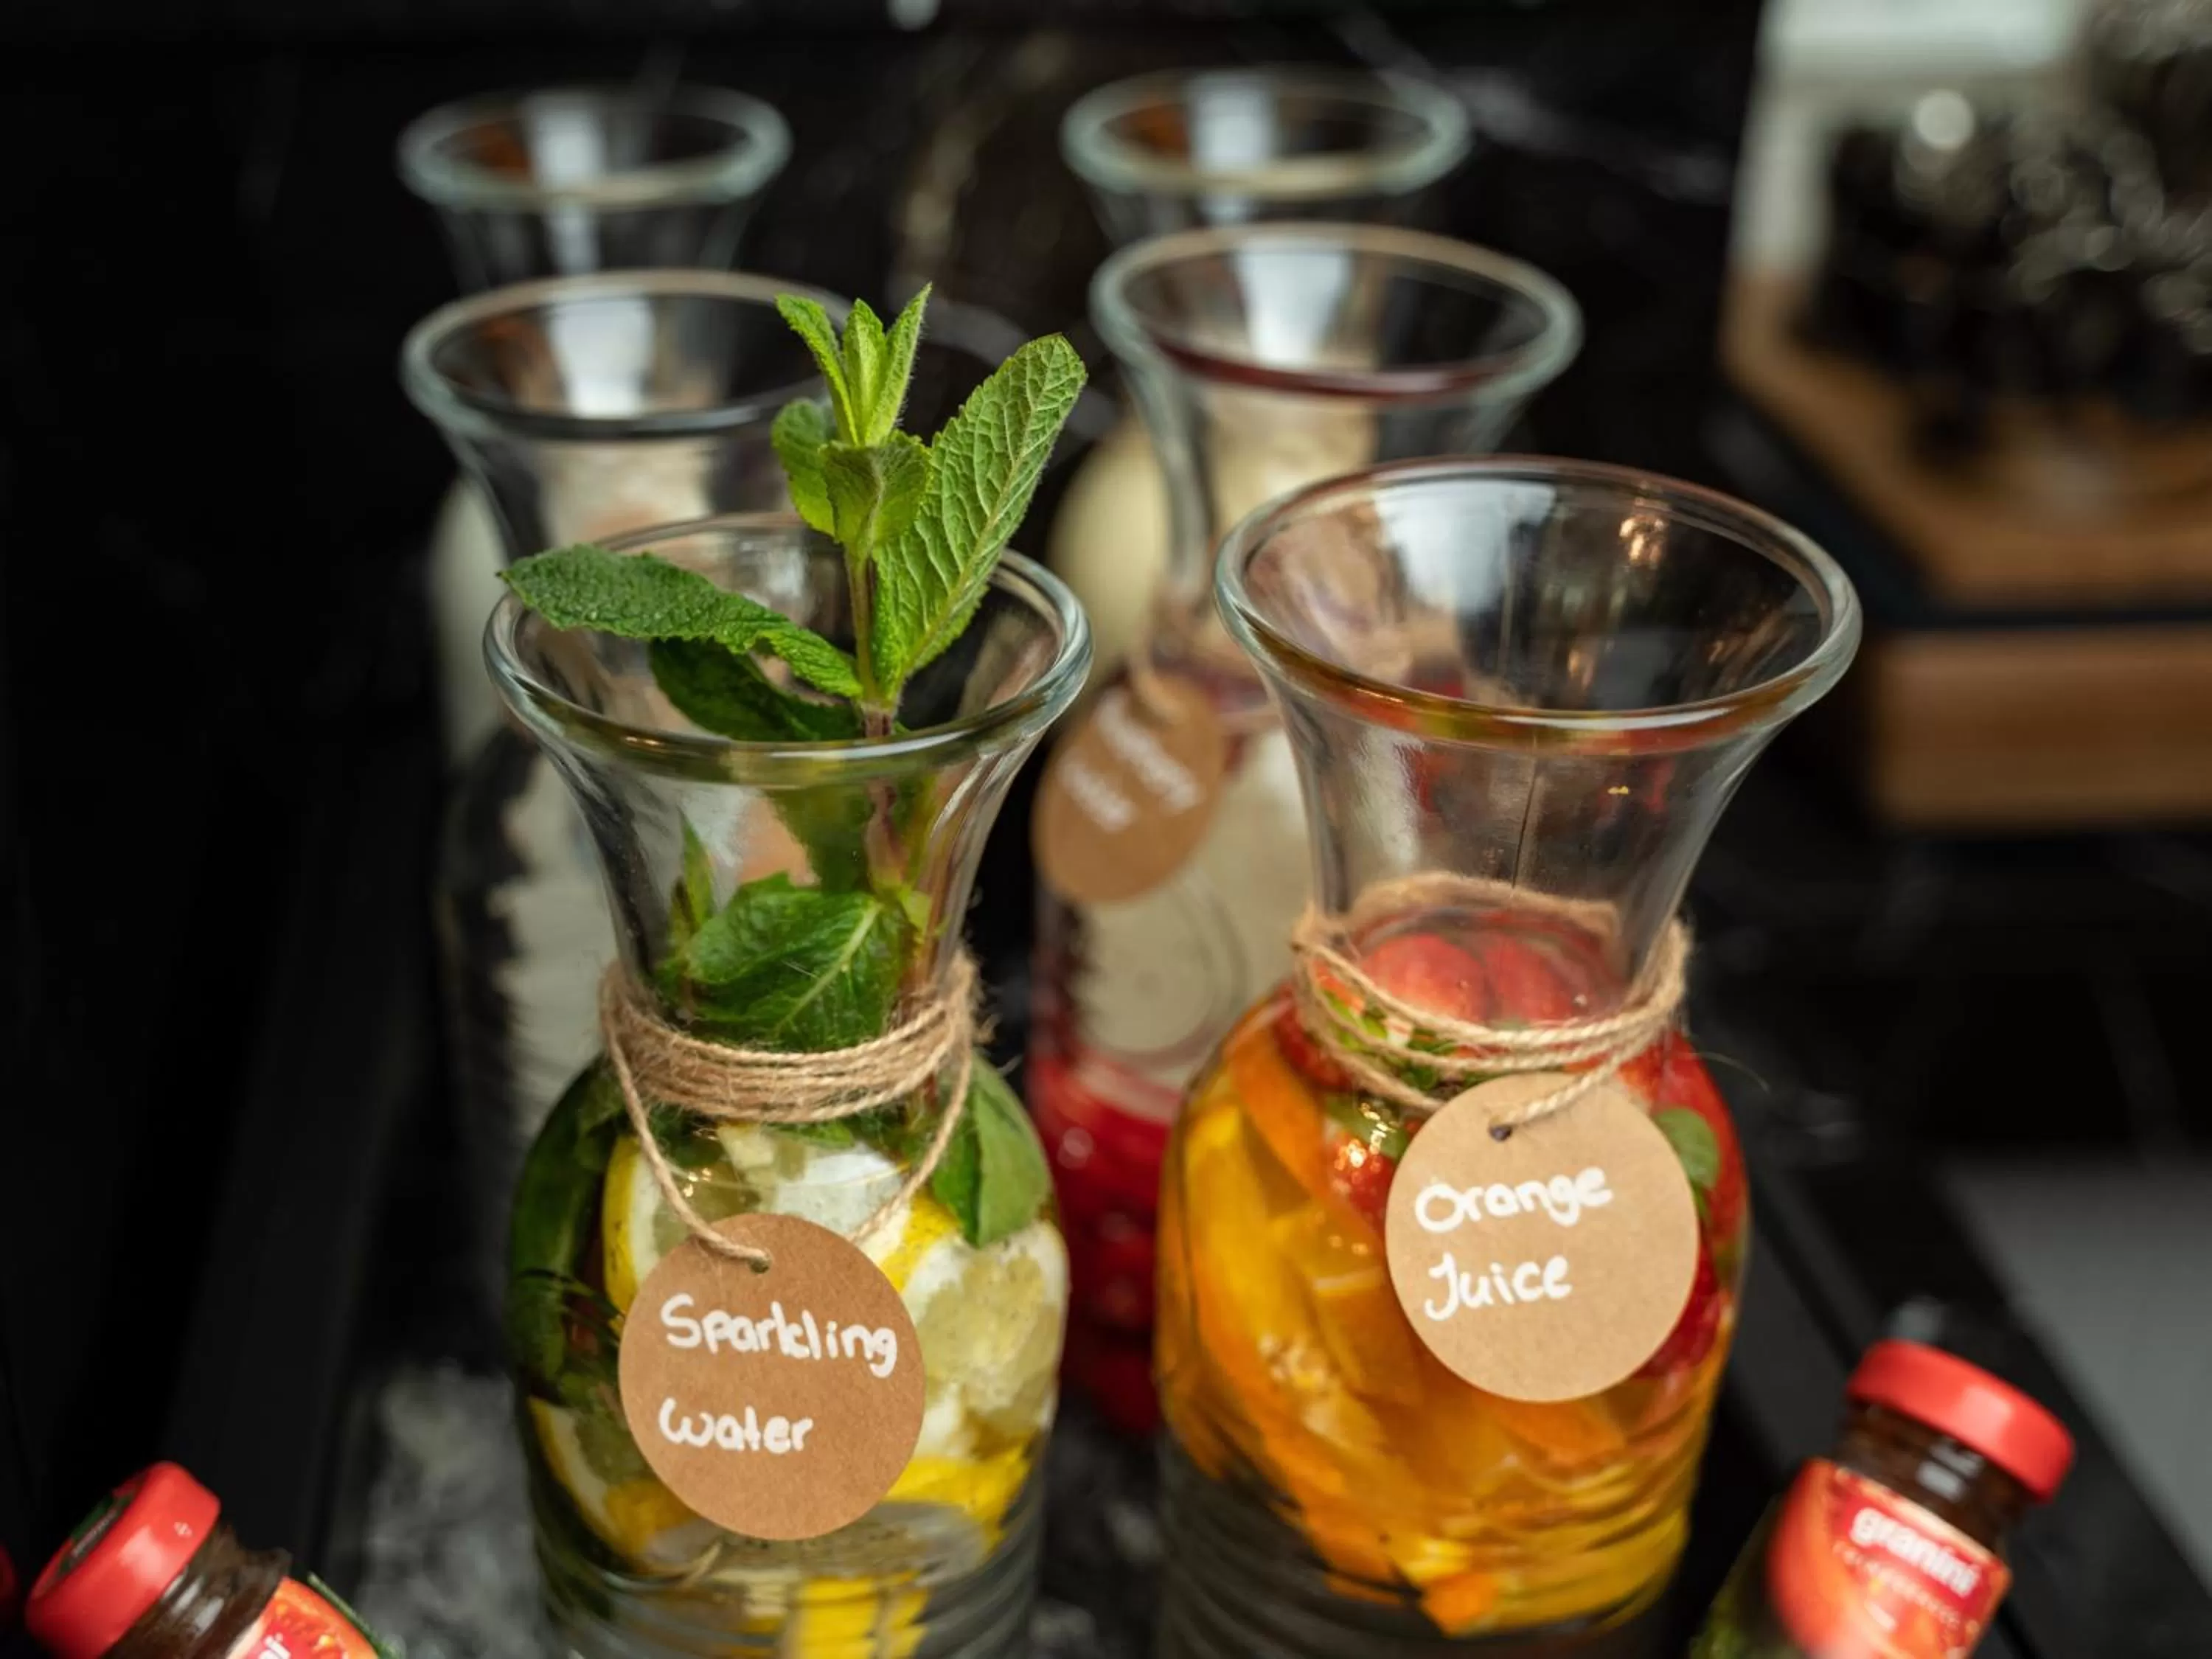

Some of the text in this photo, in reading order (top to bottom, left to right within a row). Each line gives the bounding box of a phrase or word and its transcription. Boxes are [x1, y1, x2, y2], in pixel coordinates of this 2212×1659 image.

[1415, 1166, 1613, 1233] Orange
[1424, 1252, 1572, 1321] Juice
[661, 1293, 898, 1378] Sparkling
